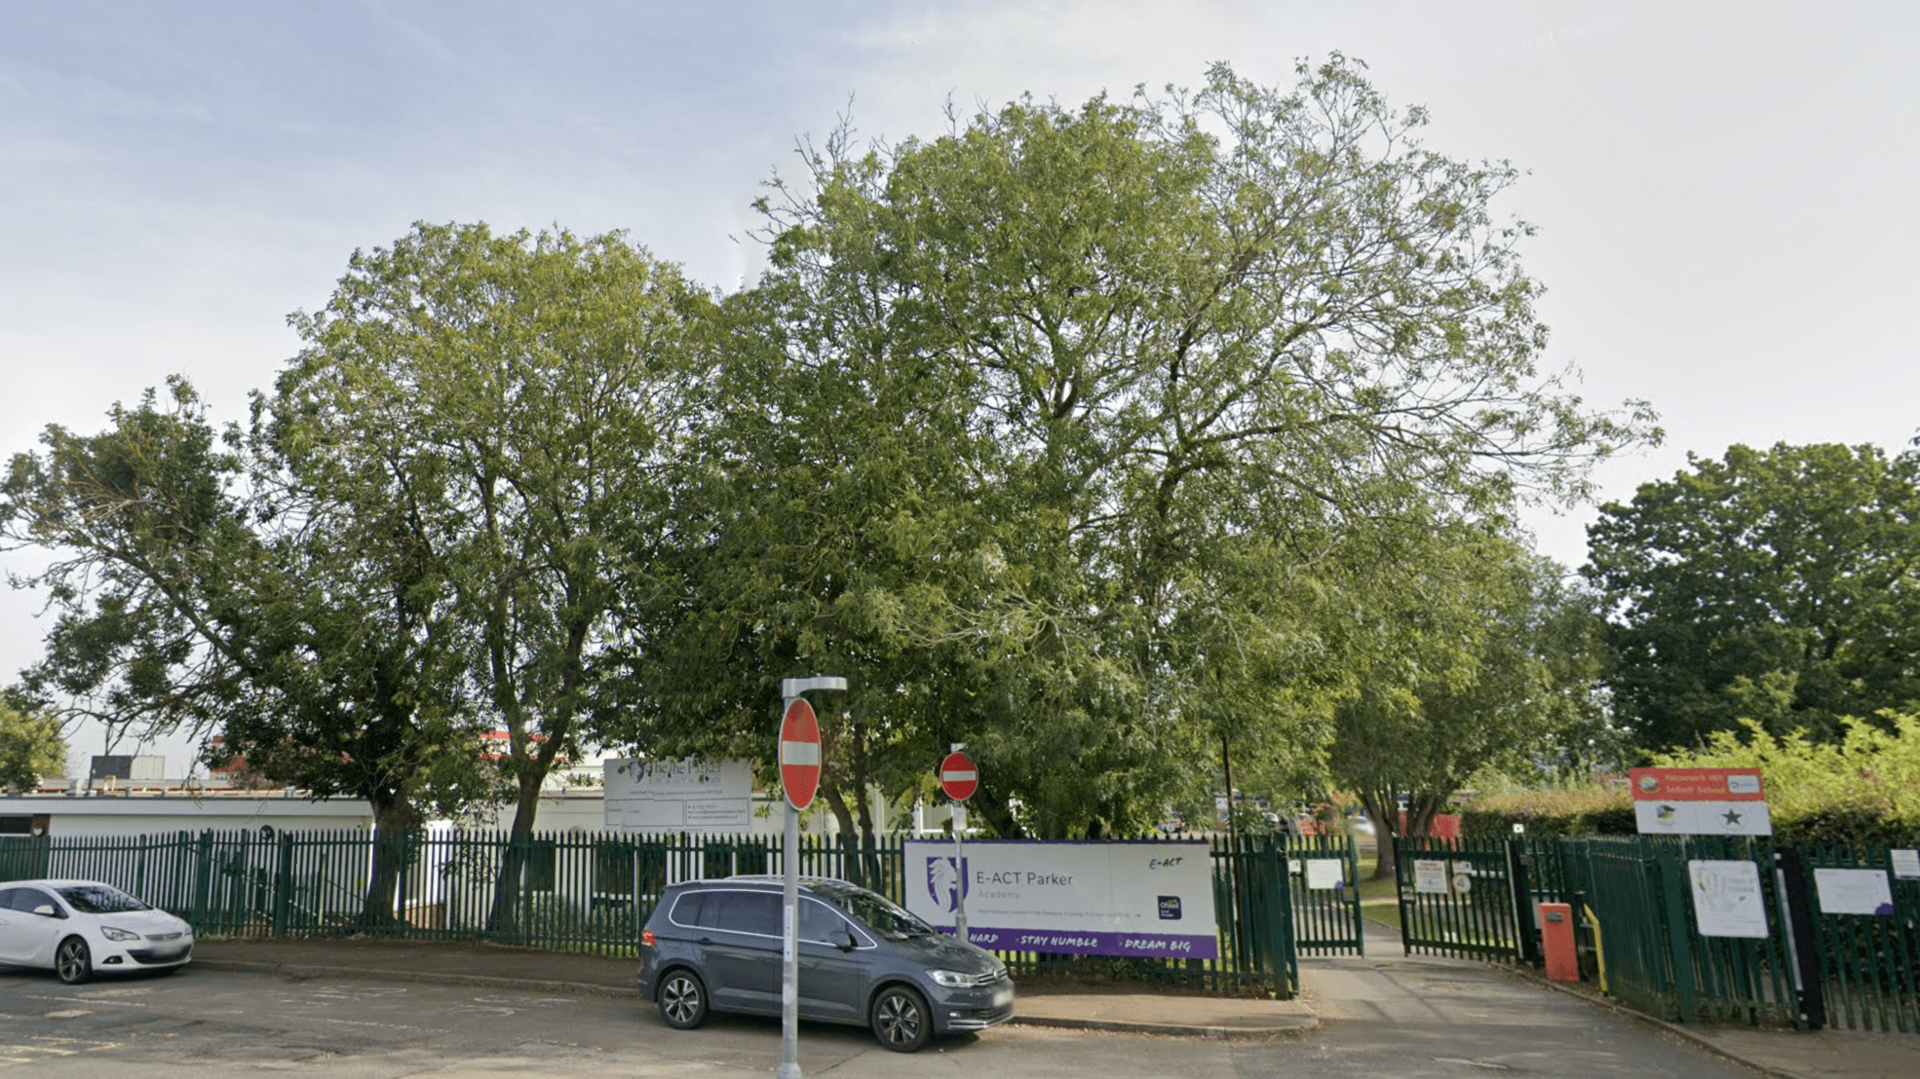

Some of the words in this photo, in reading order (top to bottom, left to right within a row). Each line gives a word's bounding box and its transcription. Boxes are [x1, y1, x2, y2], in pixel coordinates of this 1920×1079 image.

[1149, 857, 1183, 870] E-ACT
[976, 871, 1022, 884] E-ACT
[1027, 872, 1074, 886] Parker
[977, 889, 1021, 900] Academy
[969, 933, 999, 944] HARD
[1020, 935, 1048, 946] STAY
[1051, 936, 1098, 947] HUMBLE
[1124, 938, 1167, 950] DREAM
[1170, 940, 1191, 953] BIG
